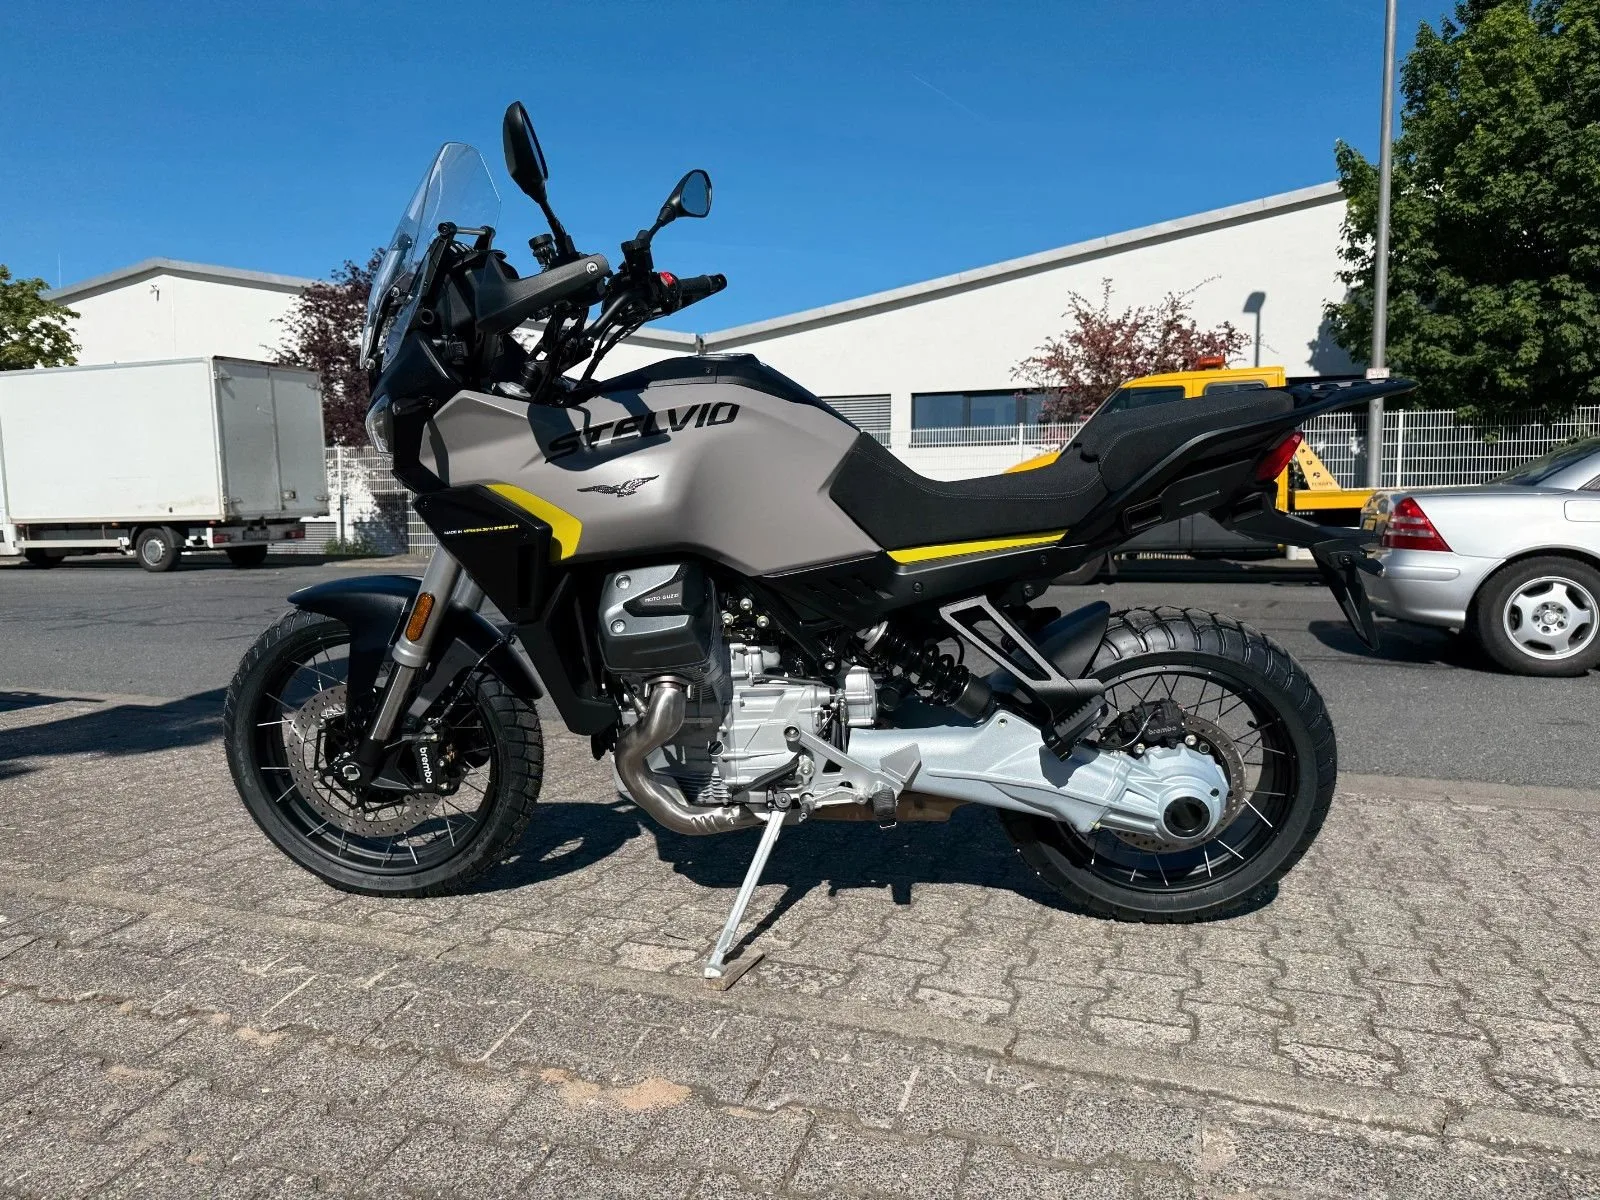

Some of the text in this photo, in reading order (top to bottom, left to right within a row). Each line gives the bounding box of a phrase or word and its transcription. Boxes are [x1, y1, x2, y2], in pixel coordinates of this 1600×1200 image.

[544, 402, 740, 464] STELVIO
[1148, 726, 1177, 735] brembo
[419, 746, 433, 784] brembo
